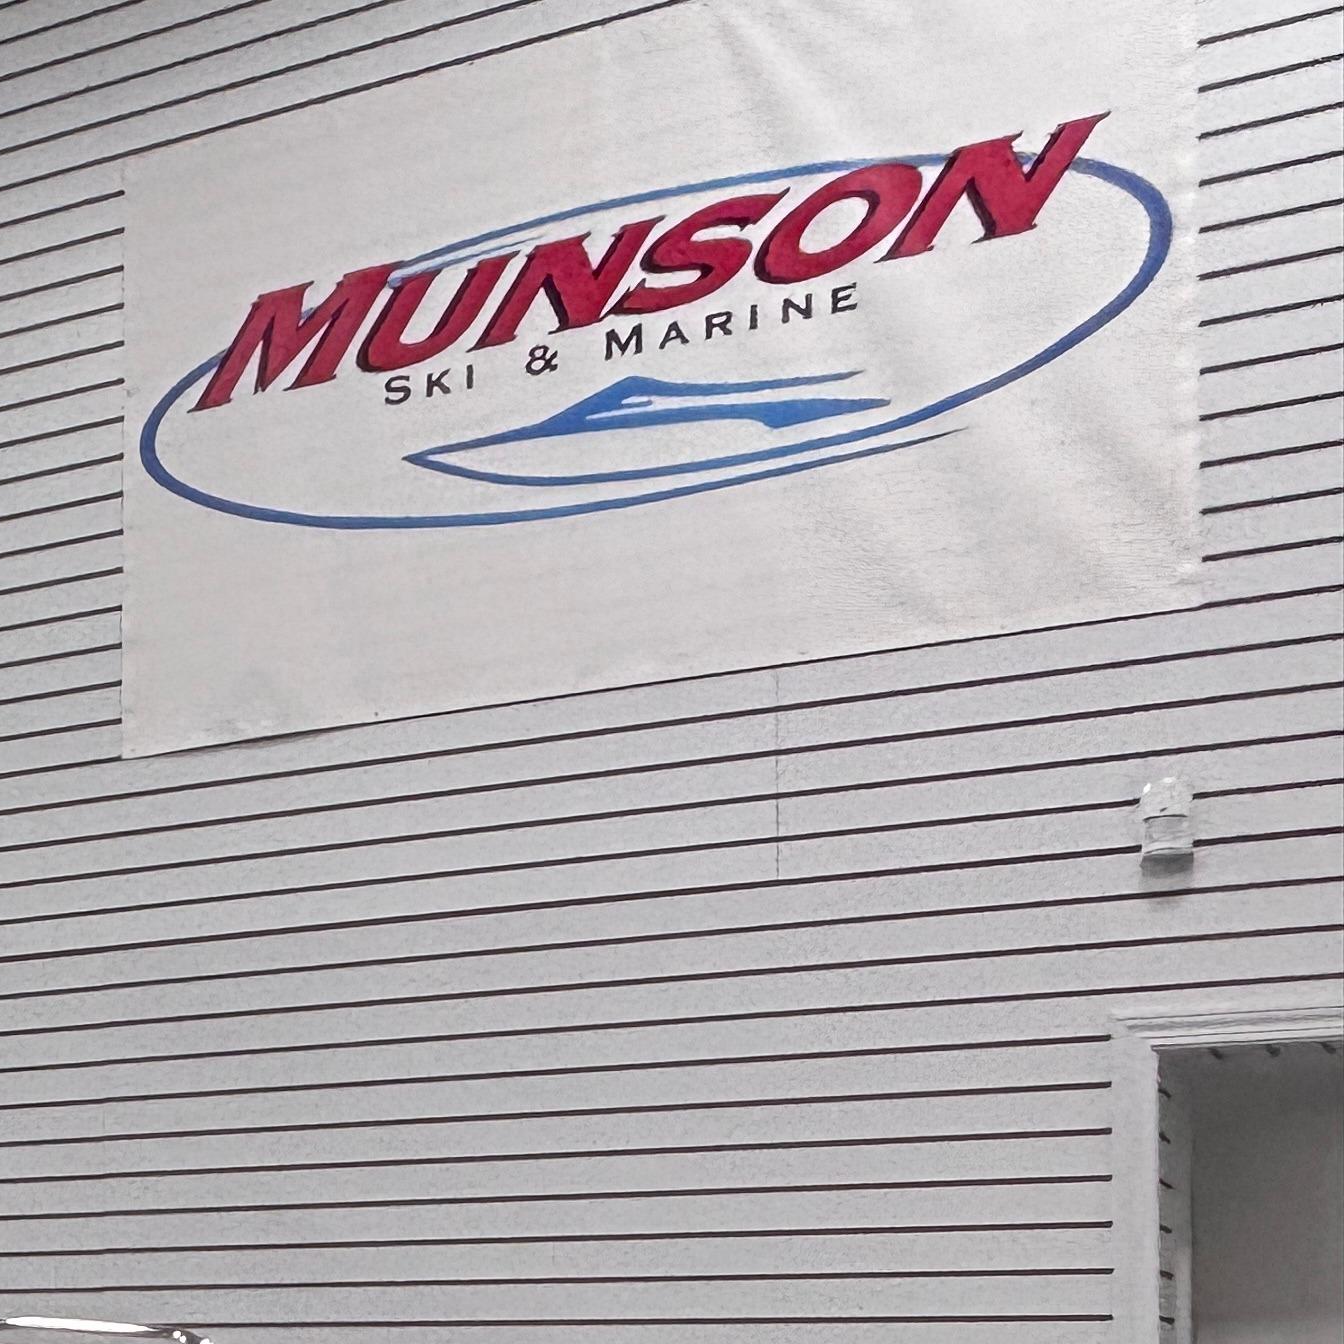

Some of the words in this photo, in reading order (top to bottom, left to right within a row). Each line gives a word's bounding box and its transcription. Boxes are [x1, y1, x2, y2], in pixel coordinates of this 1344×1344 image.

[189, 110, 1111, 412] MUNSON
[385, 364, 475, 405] SKI
[525, 345, 558, 376] &
[605, 282, 860, 361] MARINE
